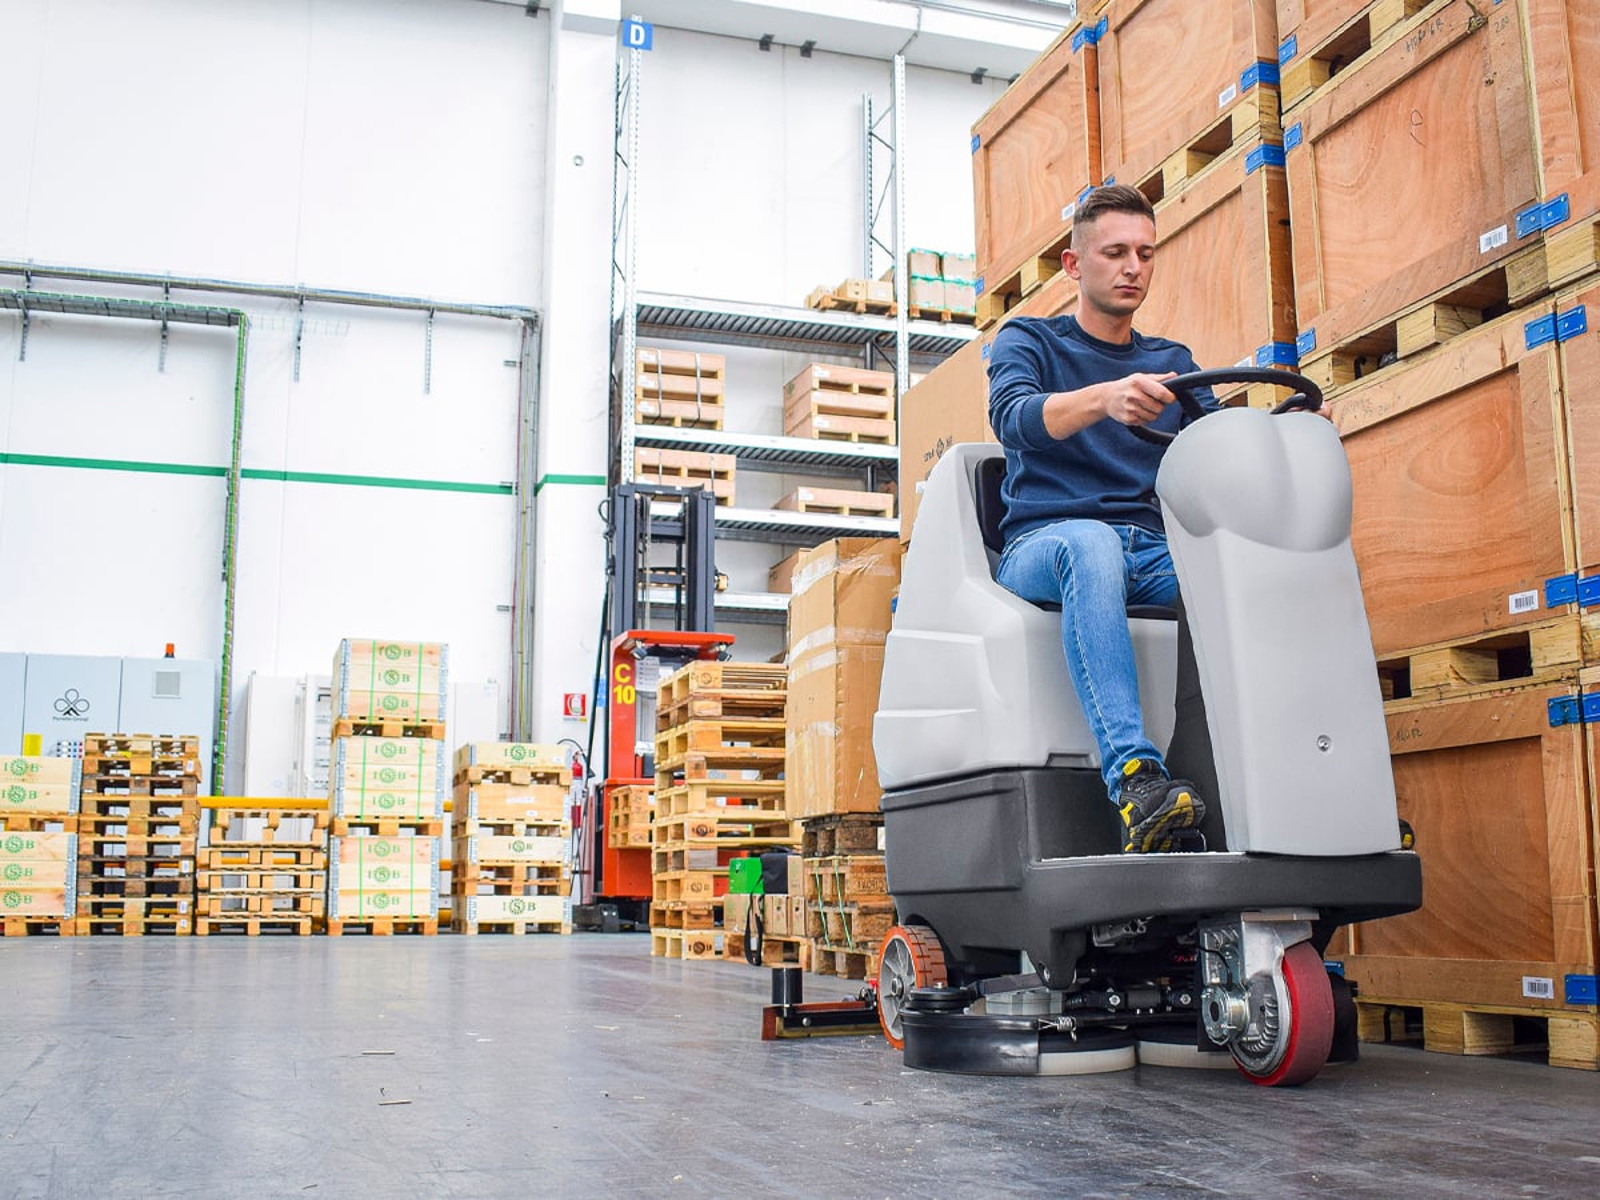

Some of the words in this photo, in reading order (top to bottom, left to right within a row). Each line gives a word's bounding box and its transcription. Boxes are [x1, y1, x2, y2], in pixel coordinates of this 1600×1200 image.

[630, 23, 646, 46] D
[613, 663, 631, 684] C
[613, 684, 636, 705] 10
